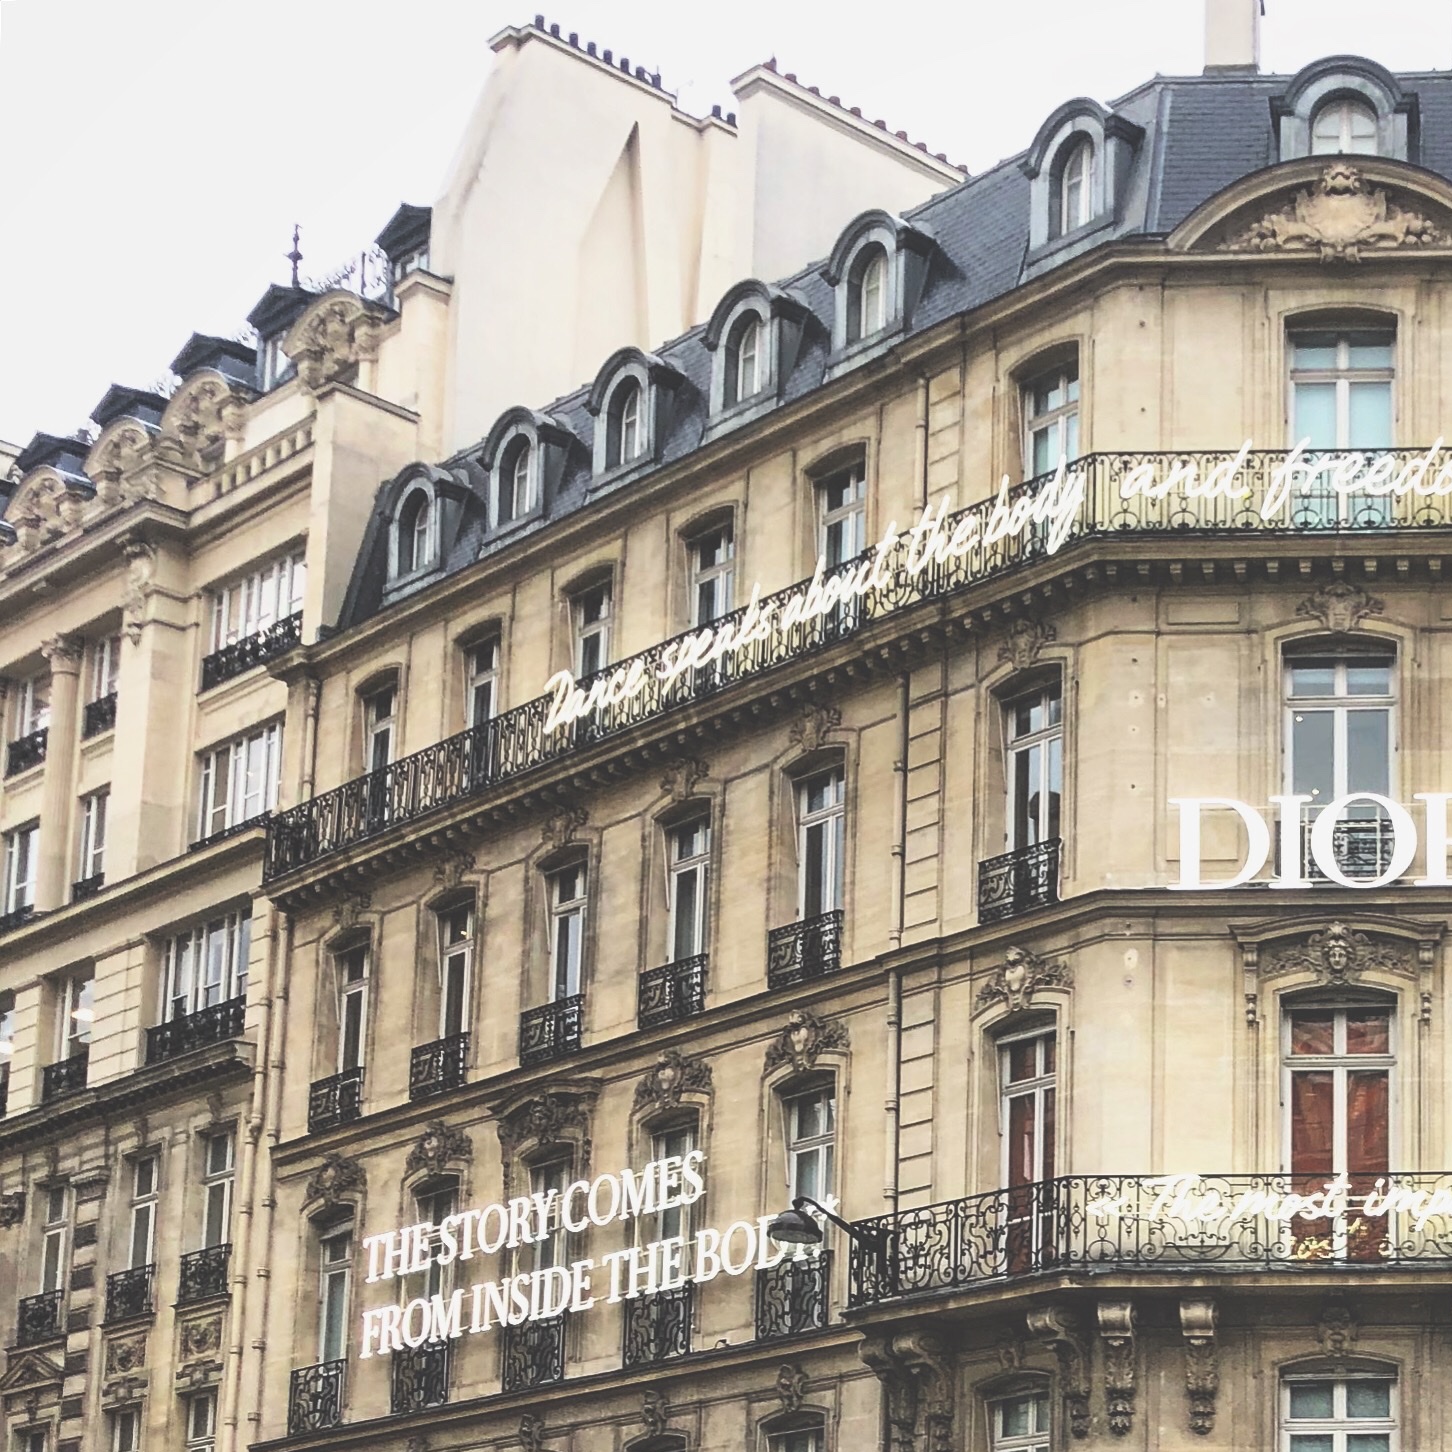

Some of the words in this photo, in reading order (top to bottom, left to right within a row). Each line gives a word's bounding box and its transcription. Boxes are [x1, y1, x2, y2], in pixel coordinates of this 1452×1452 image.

[543, 657, 648, 734] Dance
[656, 583, 777, 695] speaks
[780, 522, 897, 629] about
[906, 494, 980, 573] the
[982, 455, 1085, 554] body
[1120, 439, 1253, 498] and
[362, 1222, 436, 1283] THE
[437, 1189, 560, 1266] STORY
[561, 1150, 706, 1232] COMES
[1230, 1170, 1352, 1220] most
[359, 1288, 464, 1358] FROM
[470, 1259, 594, 1333] INSIDE
[602, 1239, 685, 1300] THE
